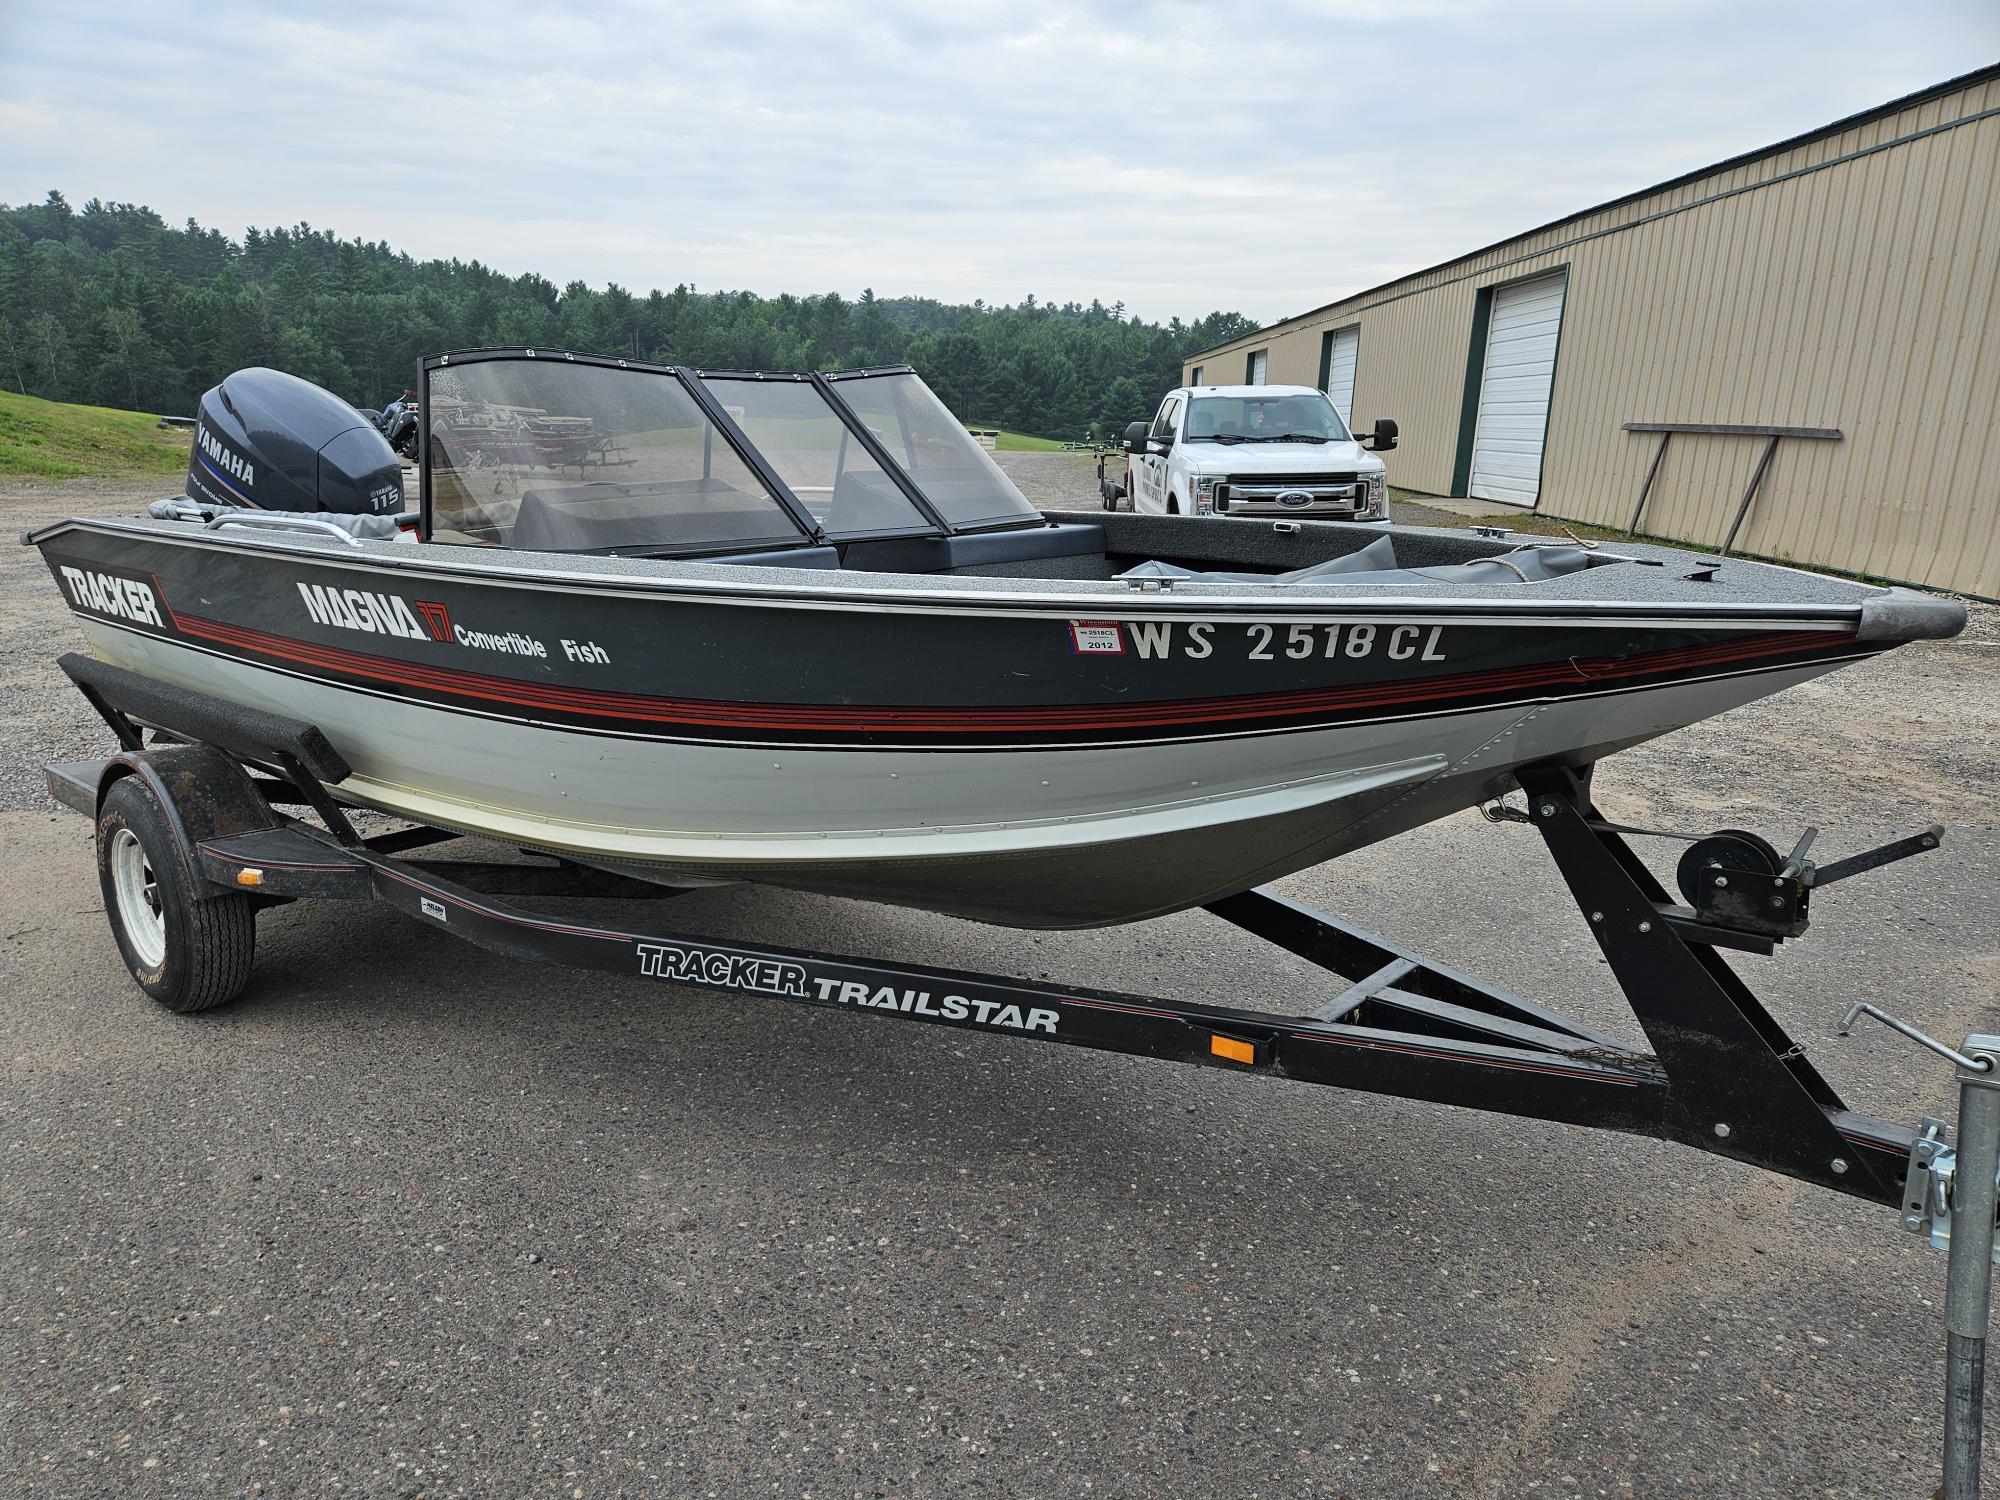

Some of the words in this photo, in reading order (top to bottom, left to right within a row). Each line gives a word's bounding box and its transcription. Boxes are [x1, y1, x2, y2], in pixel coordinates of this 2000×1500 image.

[198, 421, 254, 486] YAMAHA
[370, 488, 399, 511] 115
[60, 565, 164, 628] TRACKER
[296, 582, 431, 641] MAGNA
[454, 624, 547, 658] Convertible
[560, 639, 611, 664] Fish
[637, 943, 808, 997] TRACKER
[814, 977, 1060, 1034] TRAILSTAR
